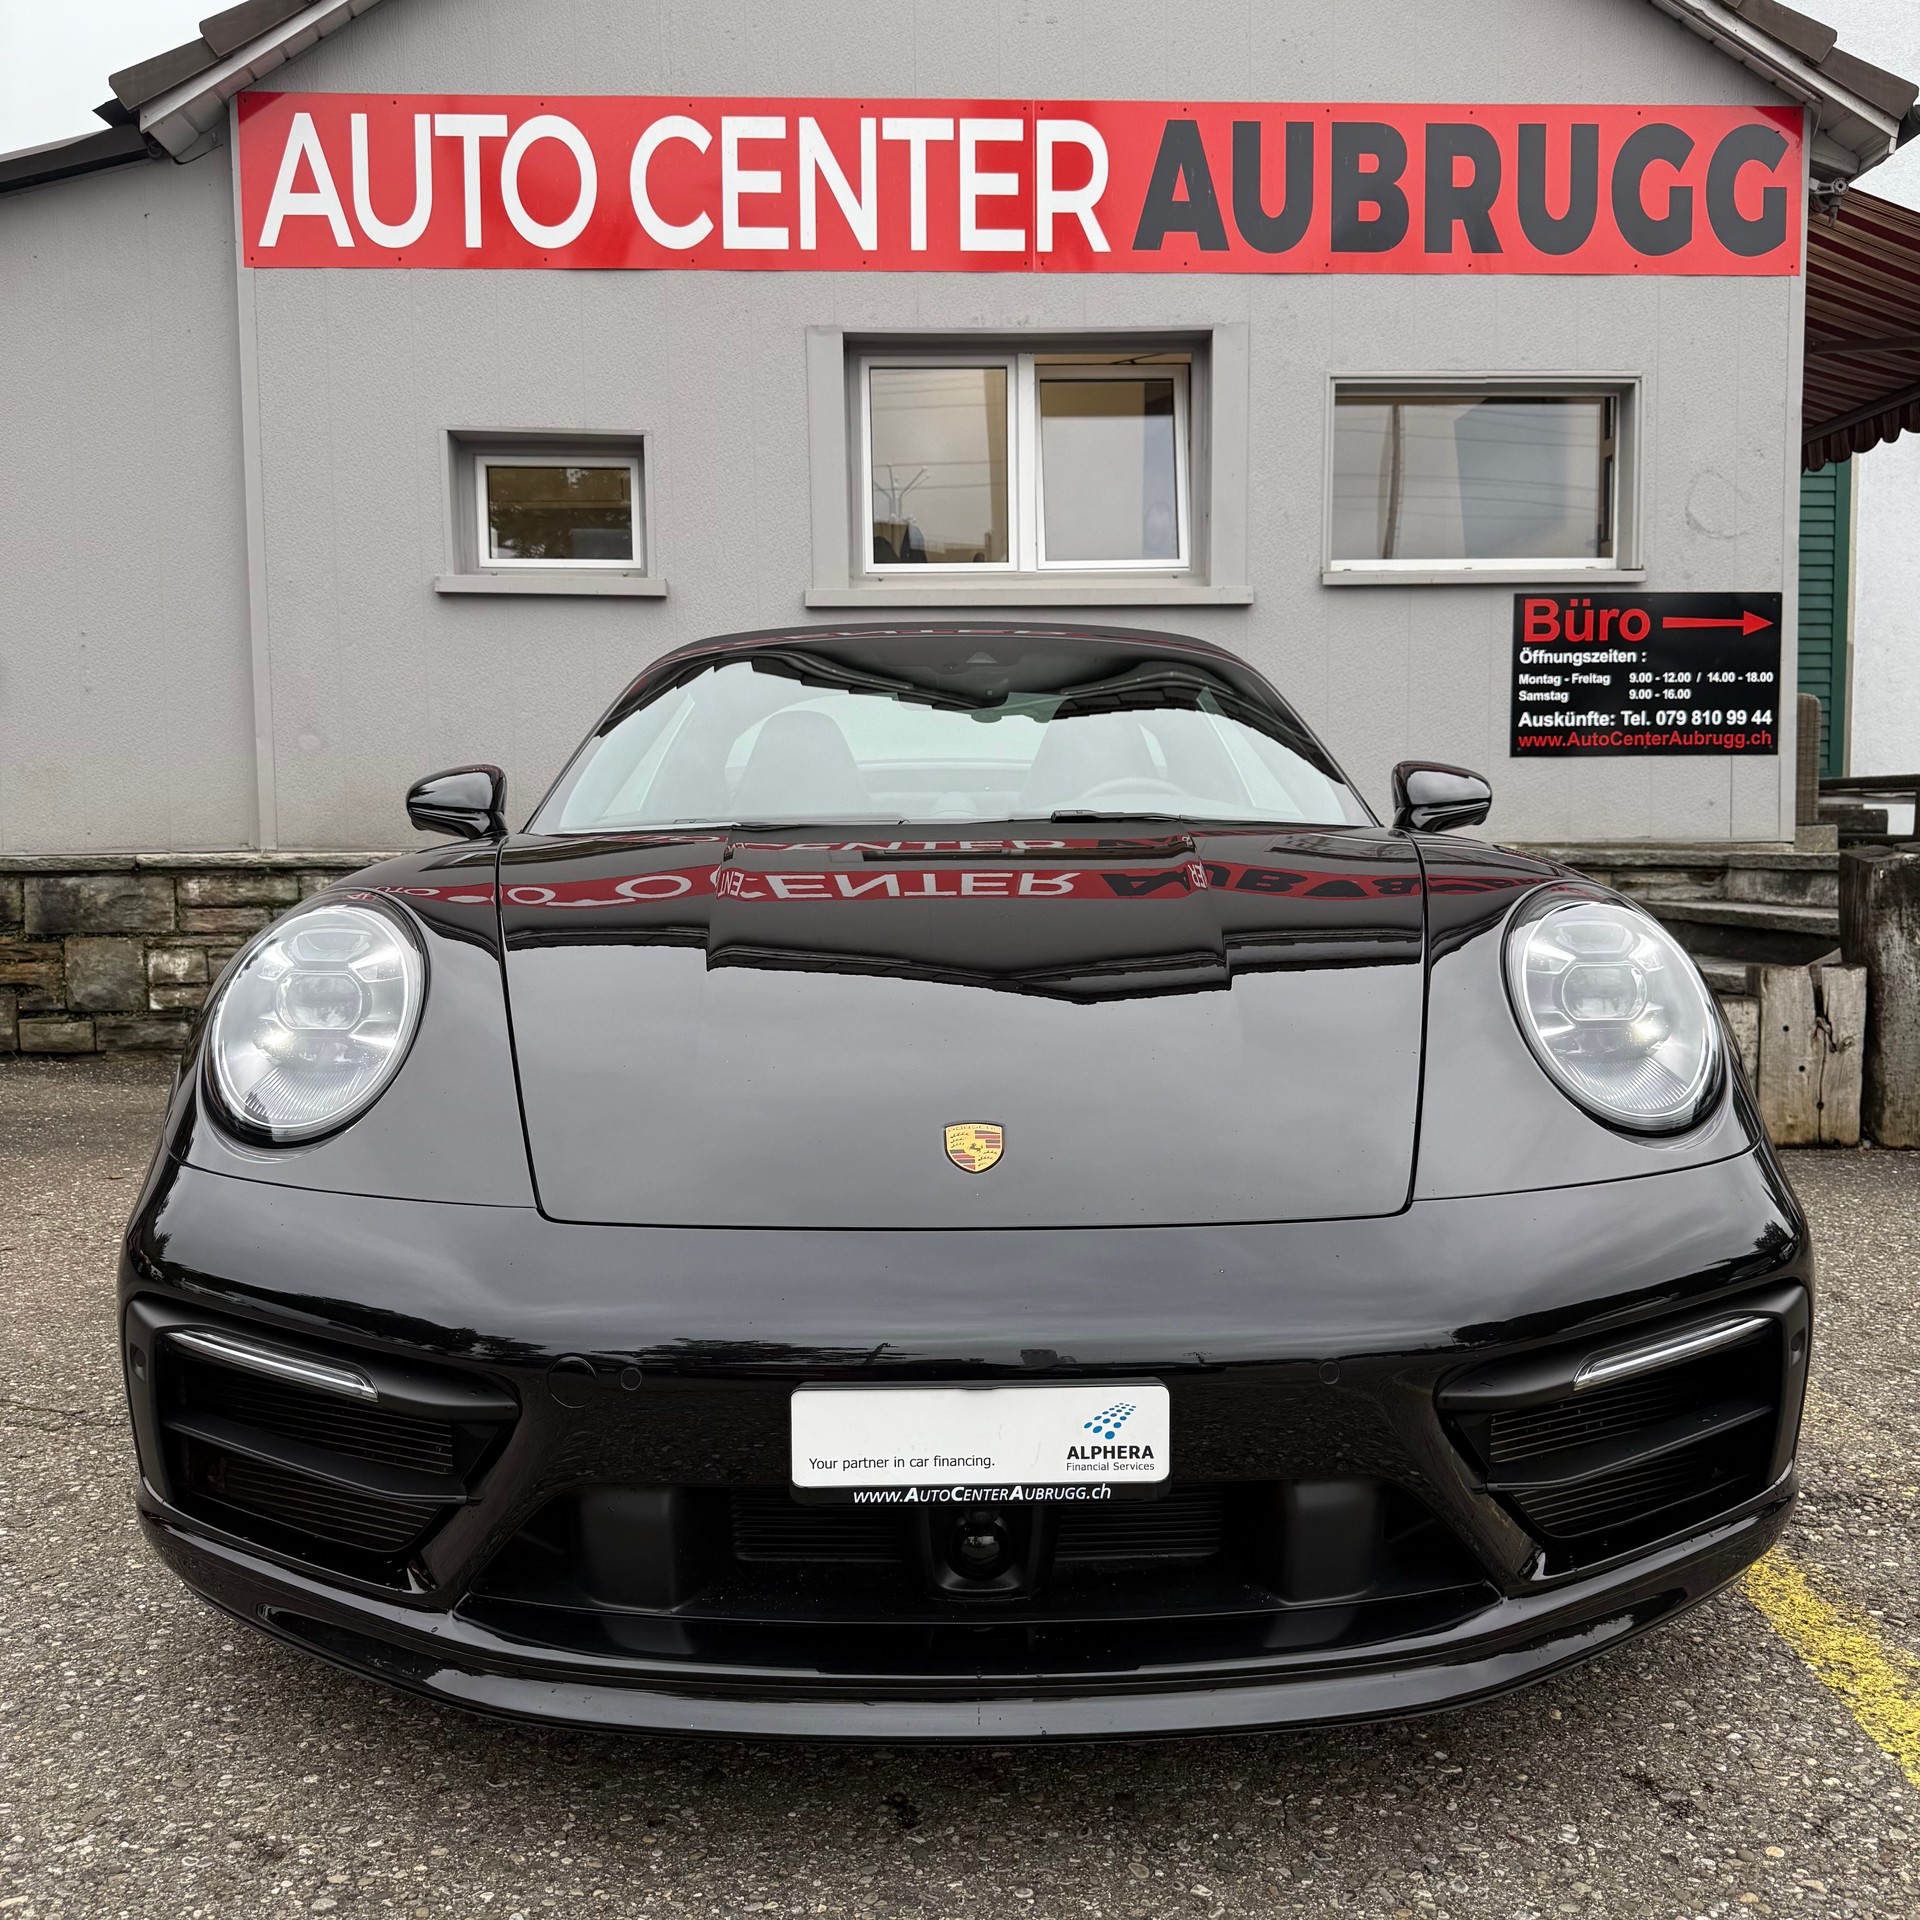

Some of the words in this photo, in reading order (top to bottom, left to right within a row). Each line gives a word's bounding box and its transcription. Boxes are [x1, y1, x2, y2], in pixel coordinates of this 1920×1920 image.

[258, 112, 598, 250] AUTO
[630, 114, 1112, 253] CENTER
[1132, 119, 1790, 258] AUBRUGG
[1523, 598, 1651, 642] Büro
[1519, 646, 1637, 667] Öffnungszeiten
[1518, 672, 1562, 687] Montag
[1571, 672, 1612, 686] Freitag
[1628, 672, 1653, 684] 9.00
[1662, 671, 1691, 684] 12.00
[1706, 671, 1736, 683] 14.00
[1744, 671, 1774, 683] 18.00
[1518, 689, 1570, 703] Samstag
[1628, 688, 1653, 700] 9.00
[1662, 688, 1691, 700] 16.00
[1517, 710, 1616, 728] Auskünfte:
[1619, 709, 1651, 727] Tel.
[1655, 709, 1687, 726] 079
[1691, 709, 1722, 726] 810
[1726, 709, 1747, 726] 99
[1751, 708, 1773, 726] 44
[1518, 729, 1773, 750] www.AutoCenterAubrugg.ch
[1066, 1444, 1155, 1461] ALPHERA
[808, 1457, 839, 1470] Your
[842, 1456, 890, 1471] partner
[893, 1455, 906, 1468] in
[909, 1456, 930, 1468] car
[933, 1454, 996, 1470] financing.
[1066, 1461, 1110, 1472] Financial
[1112, 1461, 1155, 1472] Services
